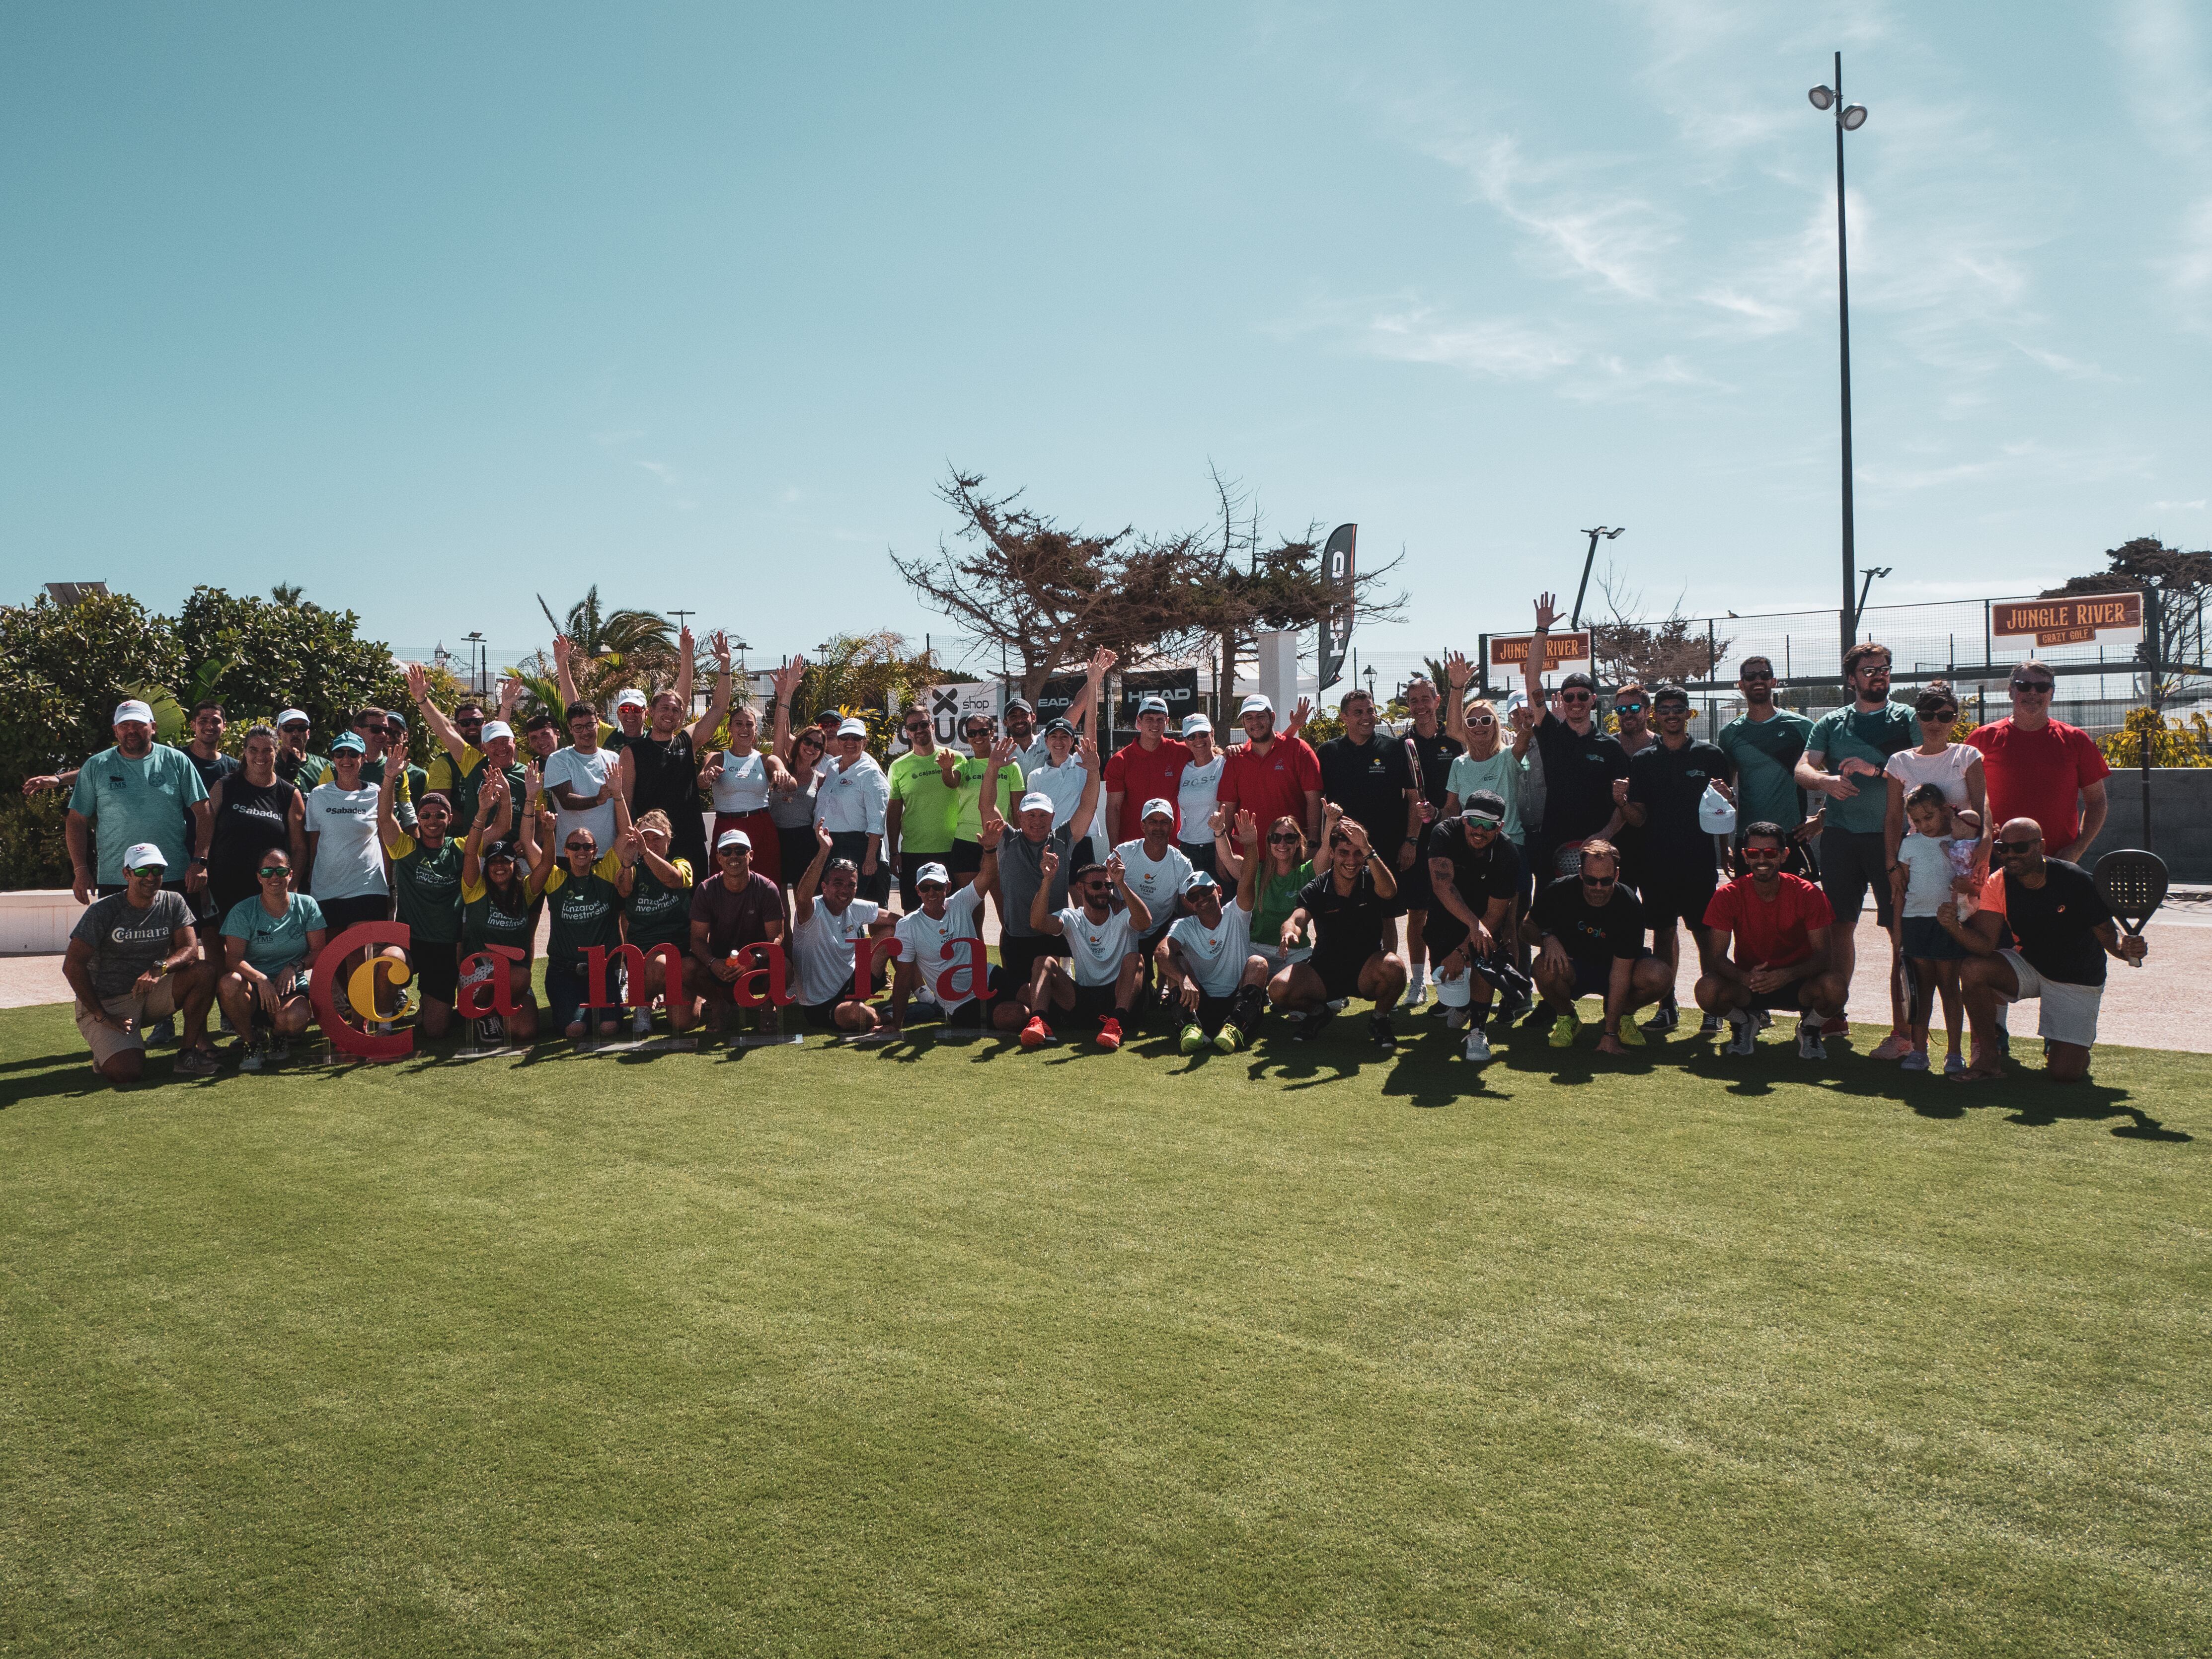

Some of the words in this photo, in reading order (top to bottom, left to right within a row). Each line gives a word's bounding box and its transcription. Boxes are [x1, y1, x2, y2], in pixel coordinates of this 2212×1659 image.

[2007, 607, 2068, 629] JUNGLE
[2076, 603, 2126, 624] RIVER
[2043, 633, 2066, 644] CRAZY
[2070, 629, 2088, 640] GOLF
[1500, 642, 1529, 660] JUNG
[1546, 639, 1579, 657] RIVER
[963, 695, 989, 711] shop
[1038, 697, 1069, 707] EAD
[1128, 688, 1190, 703] HEAD
[238, 805, 283, 821] Sabadell
[1578, 920, 1606, 938] Gogle
